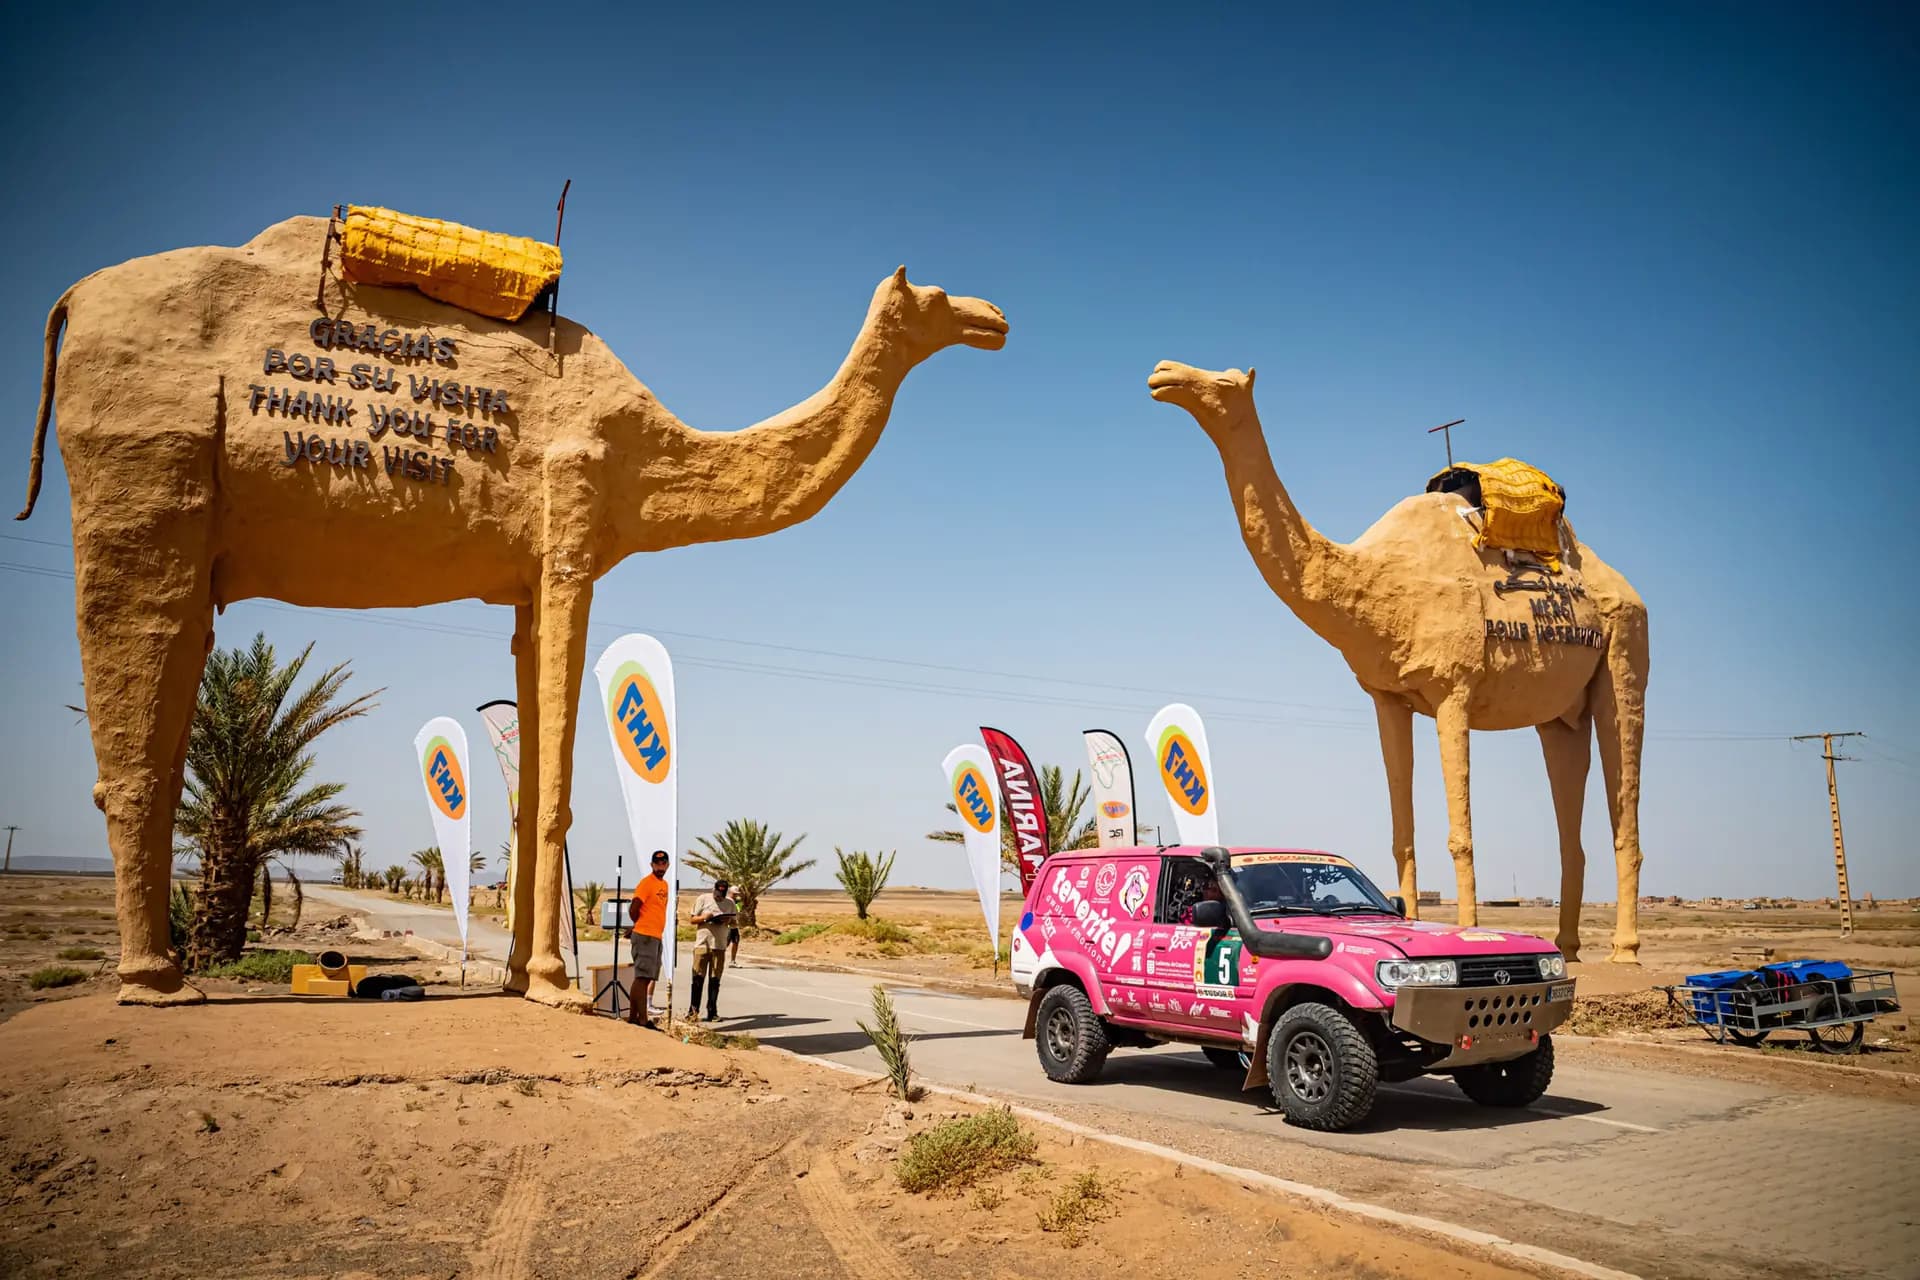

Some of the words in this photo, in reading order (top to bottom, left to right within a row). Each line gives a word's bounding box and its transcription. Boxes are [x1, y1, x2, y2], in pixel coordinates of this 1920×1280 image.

[310, 317, 456, 361] GRACIAS
[264, 348, 335, 381] POR
[350, 363, 395, 391] SU
[409, 374, 508, 413] VISITA
[248, 384, 353, 424] THANK
[367, 404, 432, 437] YOU
[446, 418, 499, 453] FOR
[281, 431, 370, 468] YOUR
[383, 445, 455, 485] VISIT
[1486, 619, 1529, 641] POUR
[1218, 947, 1231, 985] 5
